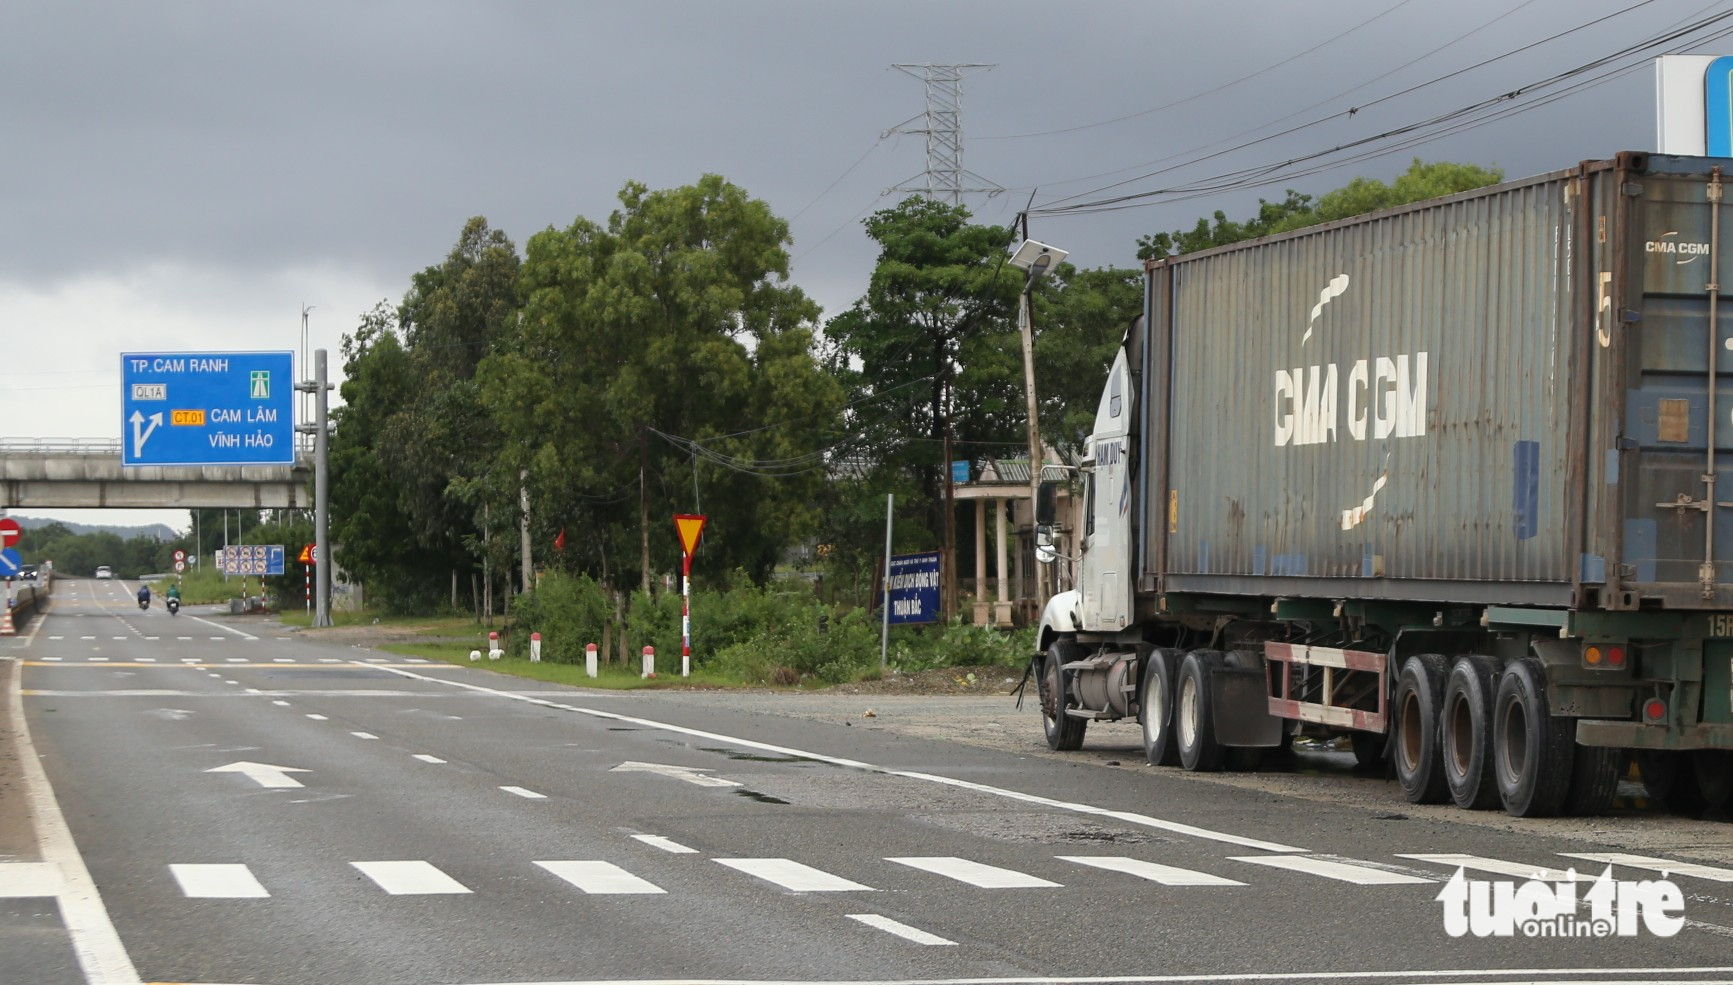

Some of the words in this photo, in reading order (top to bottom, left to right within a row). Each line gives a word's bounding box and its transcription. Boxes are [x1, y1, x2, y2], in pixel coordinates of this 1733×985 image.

[1645, 241, 1676, 253] CMA
[1678, 242, 1710, 254] CGM
[190, 358, 228, 372] RANH
[136, 386, 162, 397] QL1A
[1275, 363, 1338, 446] CMA
[1348, 351, 1428, 441] CGM
[210, 408, 241, 423] CAM
[247, 405, 277, 423] LÂM
[209, 430, 240, 448] VĨNH
[245, 429, 273, 447] HẢO
[929, 568, 939, 591] VẬT
[894, 597, 911, 620] THUẬN
